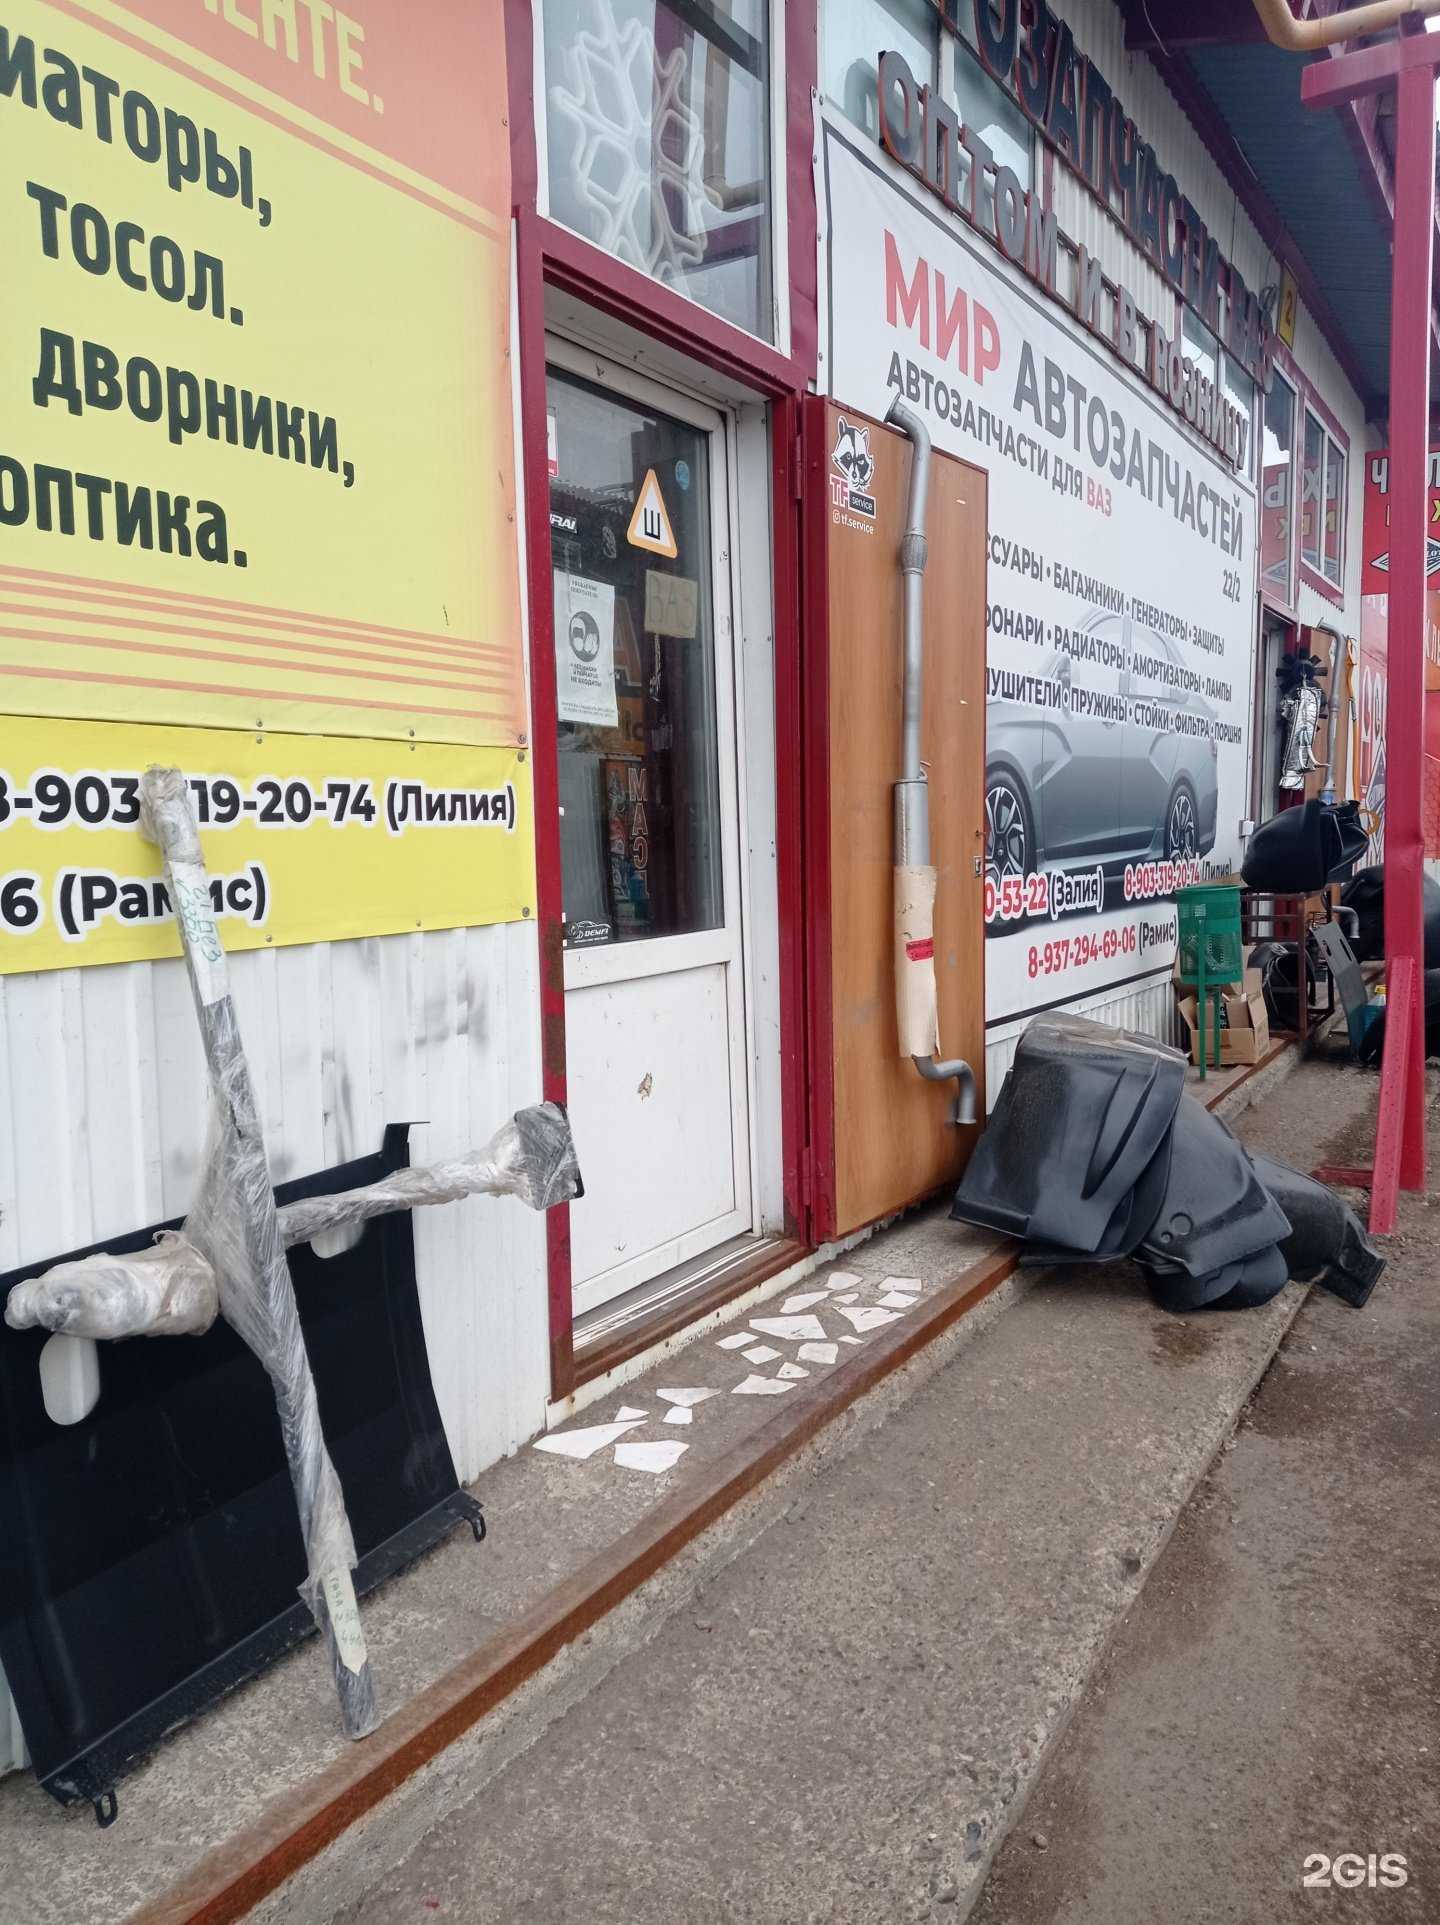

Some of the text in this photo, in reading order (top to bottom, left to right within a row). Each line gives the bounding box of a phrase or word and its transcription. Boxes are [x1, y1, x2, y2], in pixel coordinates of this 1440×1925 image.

[204, 0, 384, 114] НТЕ.
[0, 26, 271, 228] иаторы,
[27, 181, 243, 326] тосол.
[878, 50, 1249, 475] ОПТОМ И В РОЗНИЦУ
[33, 328, 355, 488] дворники,
[884, 229, 1243, 561] МИР АВТОЗАПЧАСТЕЙ
[886, 351, 1112, 517] АВТОЗАПЧАСТИ ДЛЯ ВАЗ
[0, 455, 247, 567] оптика.
[644, 508, 660, 540] Ш
[830, 474, 873, 511] TF service
[1053, 562, 1125, 615] БАГАЖНИКИ
[1131, 597, 1188, 639] ГЕНЕРАТОРЫ
[1192, 625, 1225, 656] ЗАЩИТЫ
[1223, 569, 1241, 603] 22/2
[1054, 624, 1126, 671] РАДИАТОРЫ
[1132, 653, 1201, 694] АМОРТИЗАТОРЫ
[1205, 679, 1232, 702] ЛАМПЫ
[1070, 688, 1127, 722] ПРУЖИНЫ
[1134, 701, 1169, 731] СТОЙКИ
[1175, 711, 1210, 738] ФИЛЬТРА
[1214, 723, 1242, 745] ПОРШНЯ
[0, 775, 515, 831] -90319-20-74 (Лилия)
[1051, 868, 1102, 916] (Залия)
[1125, 861, 1200, 897] 8-903-319-20-74
[1028, 915, 1178, 979] 8-937-294-69-06 (Рамис)
